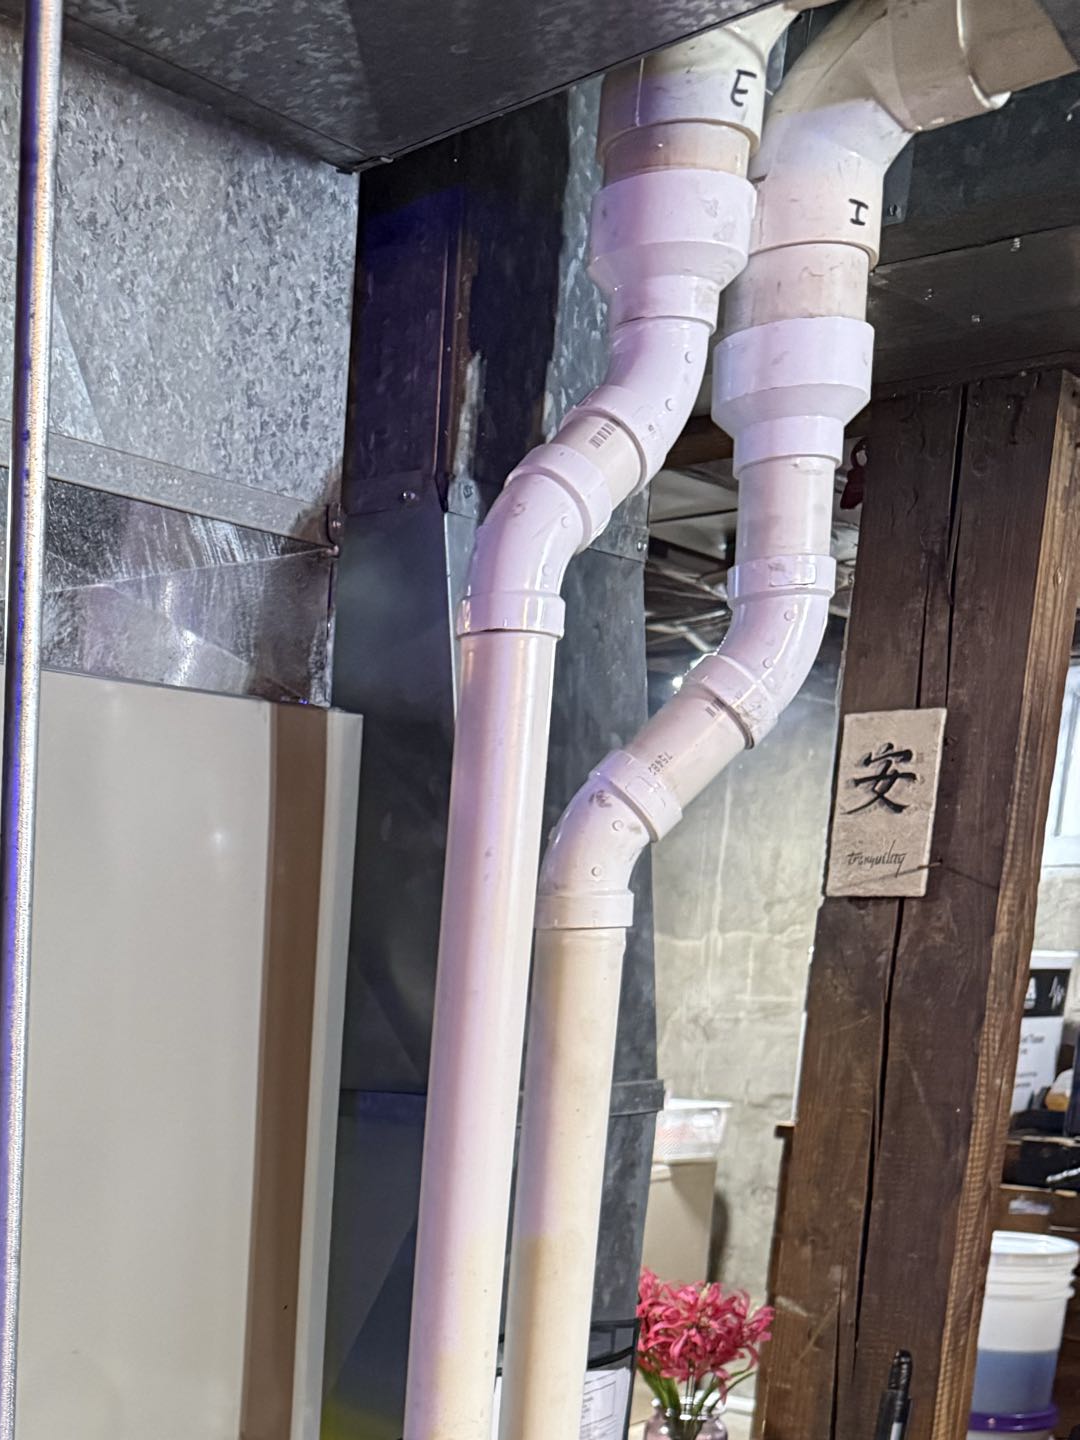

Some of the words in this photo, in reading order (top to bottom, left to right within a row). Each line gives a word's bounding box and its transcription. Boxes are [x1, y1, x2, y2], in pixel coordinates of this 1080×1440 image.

[729, 69, 758, 107] E
[847, 197, 870, 226] I
[841, 741, 918, 816] 安
[846, 839, 908, 879] tranquility
